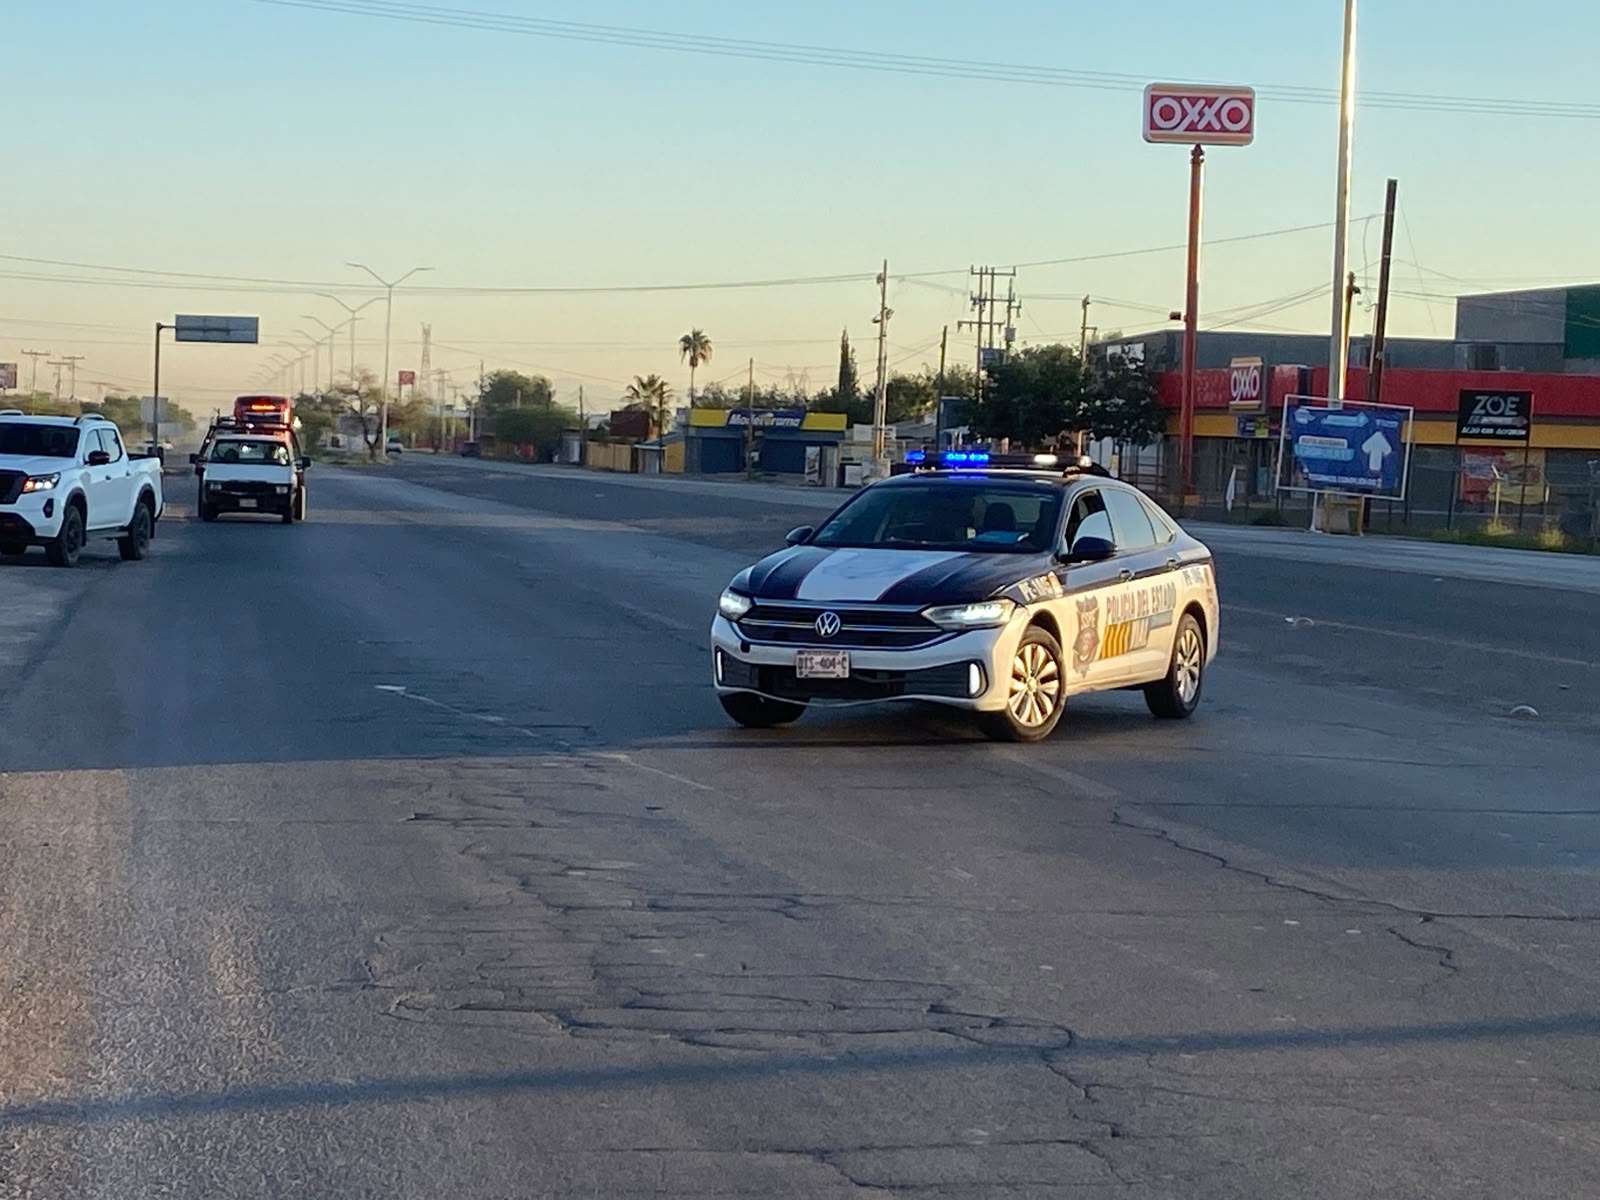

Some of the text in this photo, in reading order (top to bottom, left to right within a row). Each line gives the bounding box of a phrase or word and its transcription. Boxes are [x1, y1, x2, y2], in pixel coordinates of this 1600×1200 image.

[1152, 96, 1250, 132] OXXO
[1231, 369, 1260, 401] OXXO
[1471, 395, 1520, 415] ZOE
[1151, 582, 1177, 612] ESTADO
